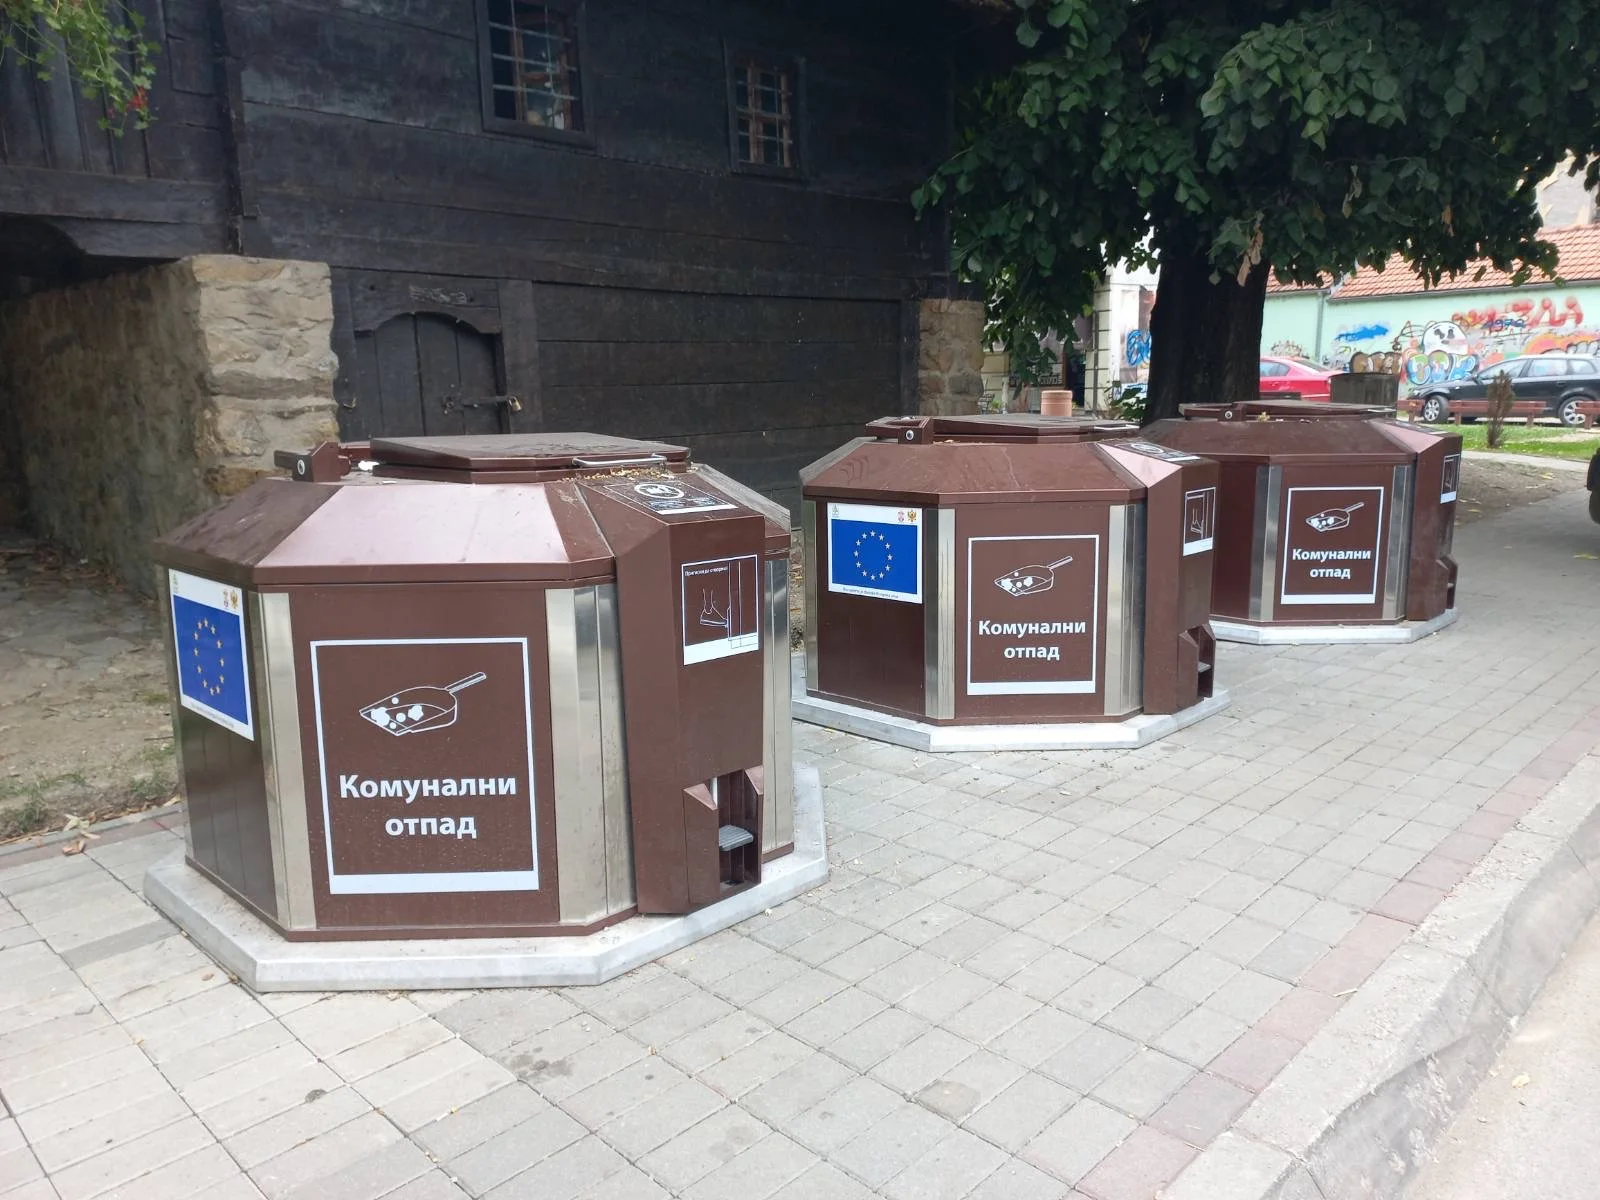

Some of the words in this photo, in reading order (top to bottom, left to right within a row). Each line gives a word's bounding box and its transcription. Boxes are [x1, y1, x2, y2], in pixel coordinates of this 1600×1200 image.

[1292, 548, 1371, 563] Комунални
[1309, 568, 1351, 579] отпад
[978, 620, 1086, 638] Комунални
[1004, 646, 1060, 661] отпад
[339, 774, 516, 804] Комунални
[385, 816, 477, 839] отпад
